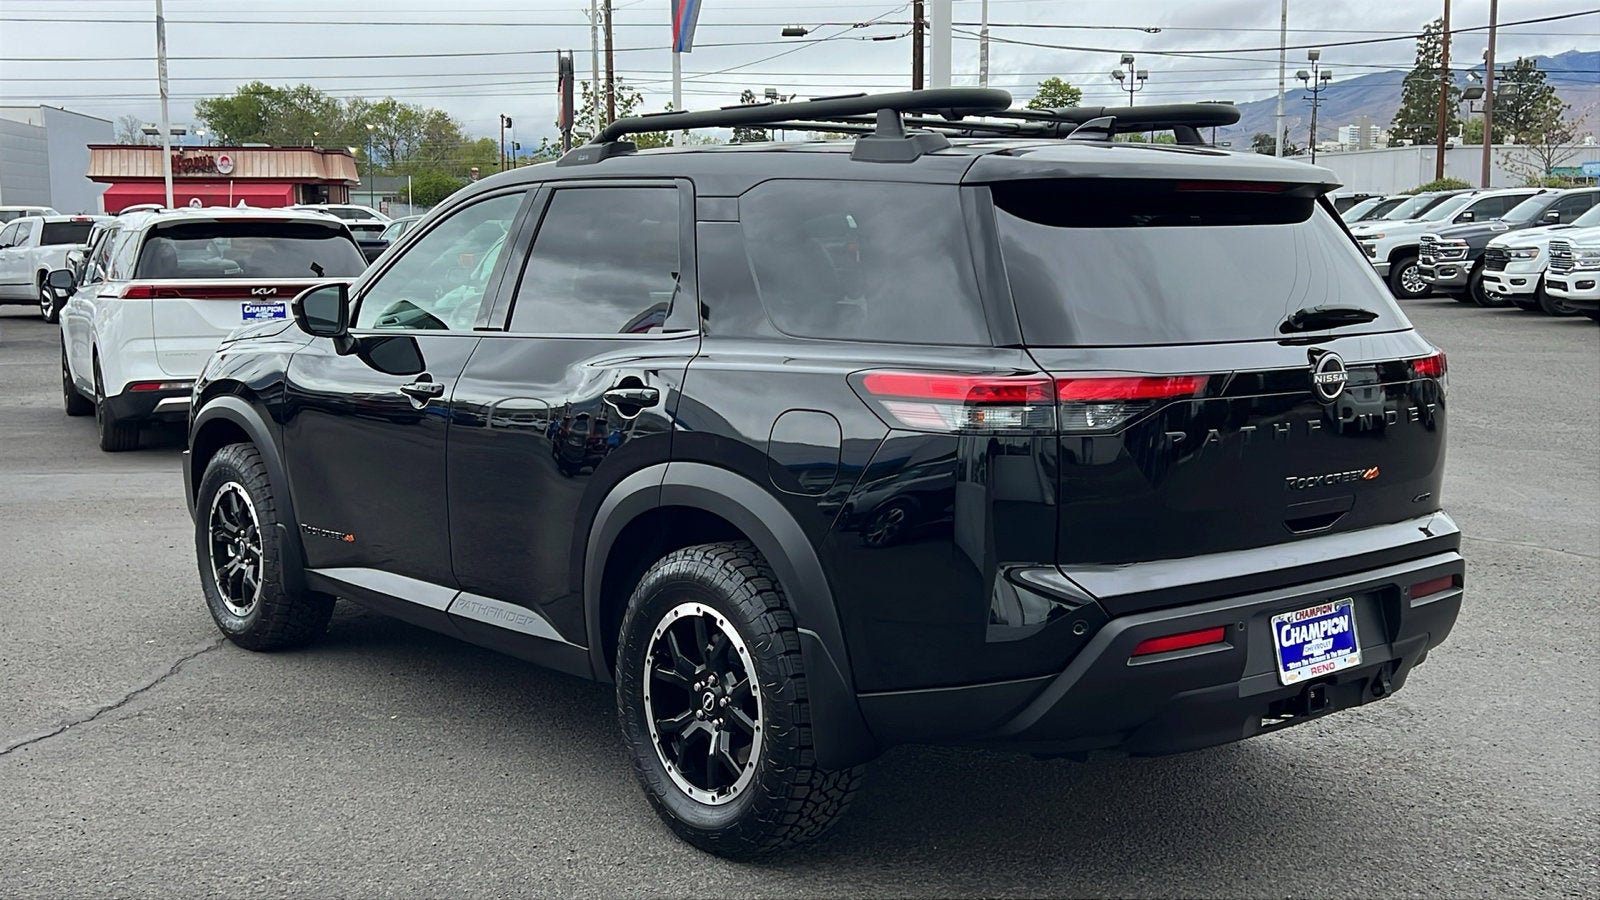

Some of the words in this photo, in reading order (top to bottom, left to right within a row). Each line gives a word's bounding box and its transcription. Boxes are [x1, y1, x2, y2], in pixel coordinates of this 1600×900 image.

[243, 305, 284, 313] CHAMPION
[1314, 373, 1348, 383] NISSAN
[1164, 403, 1436, 449] PATHFINDER
[455, 599, 536, 626] PATHFINDER
[1295, 604, 1333, 621] CHAMPION
[1281, 614, 1349, 648] CHAMPION
[1310, 661, 1336, 676] RENO
